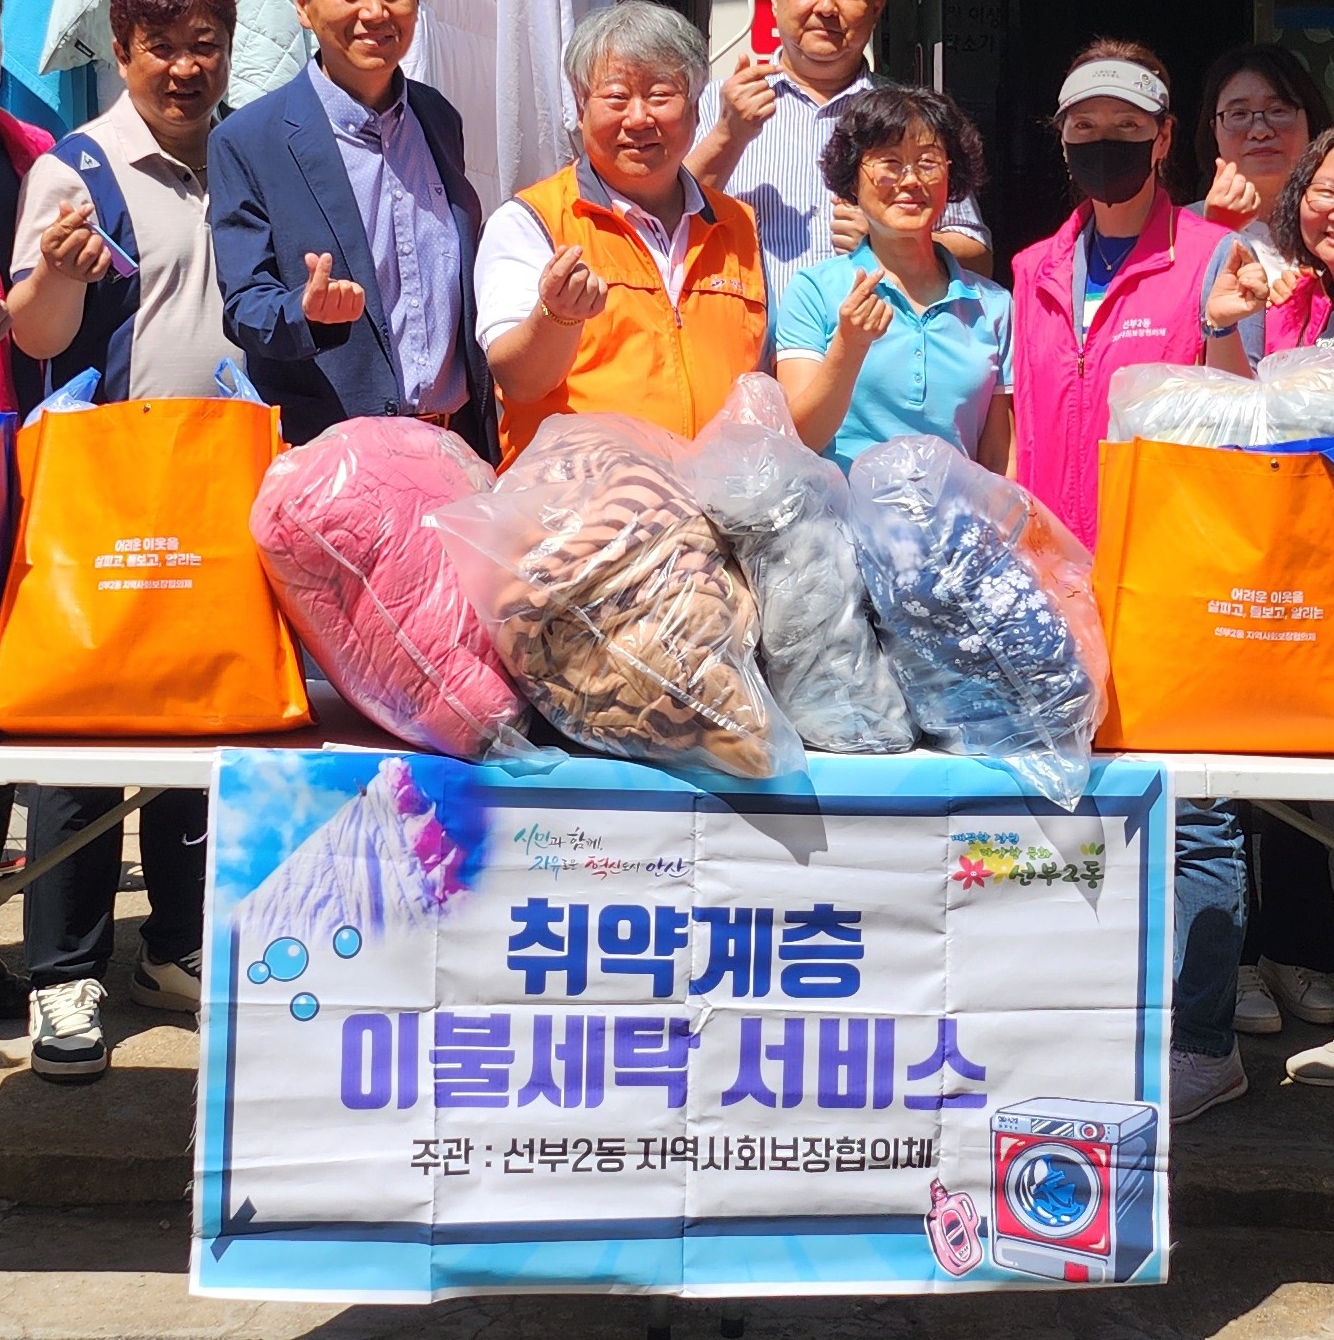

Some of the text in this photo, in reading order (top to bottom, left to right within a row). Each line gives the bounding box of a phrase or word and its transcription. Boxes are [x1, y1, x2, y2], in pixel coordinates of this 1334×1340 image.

[115, 537, 179, 552] 어려운 이웃을
[165, 553, 202, 566] 알리는
[1231, 587, 1304, 604] 어려운 이웃을
[1208, 600, 1324, 620] 살피고, 돌보고, 알리는
[514, 824, 566, 855] 시민과
[528, 856, 690, 881] 자유로운 혁신도시 안산
[1009, 861, 1104, 889] 선부2동
[507, 897, 865, 999] 취약계층
[340, 1012, 988, 1111] 이불세탁 서비스
[410, 1137, 477, 1174] 주관
[503, 1136, 627, 1174] 선부2동
[635, 1135, 934, 1174] 지역사회보장협의체
